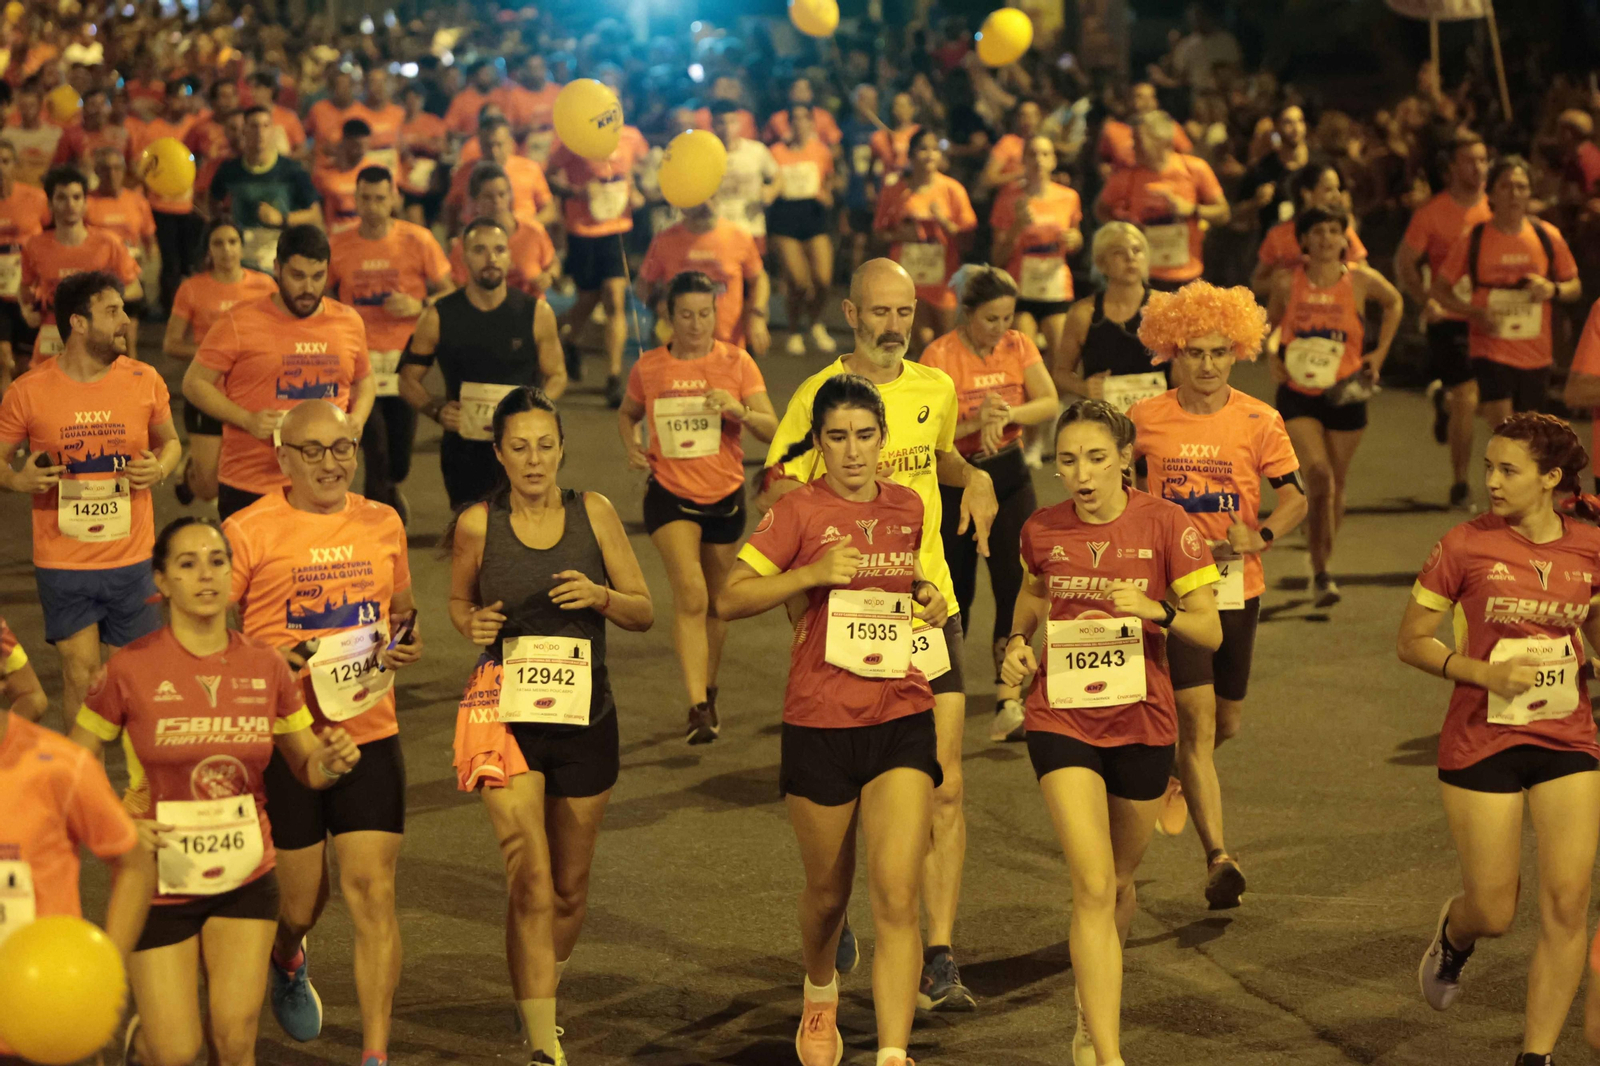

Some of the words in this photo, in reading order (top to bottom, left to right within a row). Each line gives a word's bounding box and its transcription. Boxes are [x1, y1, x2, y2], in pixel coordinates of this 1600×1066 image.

[295, 341, 328, 354] XXXV
[672, 379, 707, 390] XXXV
[973, 371, 1005, 388] XXXV
[74, 410, 112, 424] XXXV
[667, 417, 709, 431] 16139
[60, 424, 88, 433] CARRERA
[65, 429, 127, 439] GUADALQUIVIR
[1179, 443, 1221, 458] XXXV
[1162, 457, 1194, 465] CARRERA
[1197, 459, 1233, 467] NOCTURNA
[1166, 464, 1233, 474] GUADALQUIVIR
[72, 501, 118, 516] 14203
[309, 544, 354, 563] XXXV
[291, 564, 328, 574] CARRERA
[331, 560, 372, 569] NOCTURNA
[298, 568, 374, 583] GUADALQUIVIR
[846, 621, 898, 641] 15935
[1065, 649, 1126, 670] 16243
[330, 651, 380, 684] 12944
[516, 667, 575, 686] 12942
[1534, 668, 1565, 688] 951
[1087, 683, 1104, 692] KH7
[155, 715, 271, 735] ISBILYA
[155, 734, 258, 746] TRIATHLON
[180, 831, 245, 854] 16246
